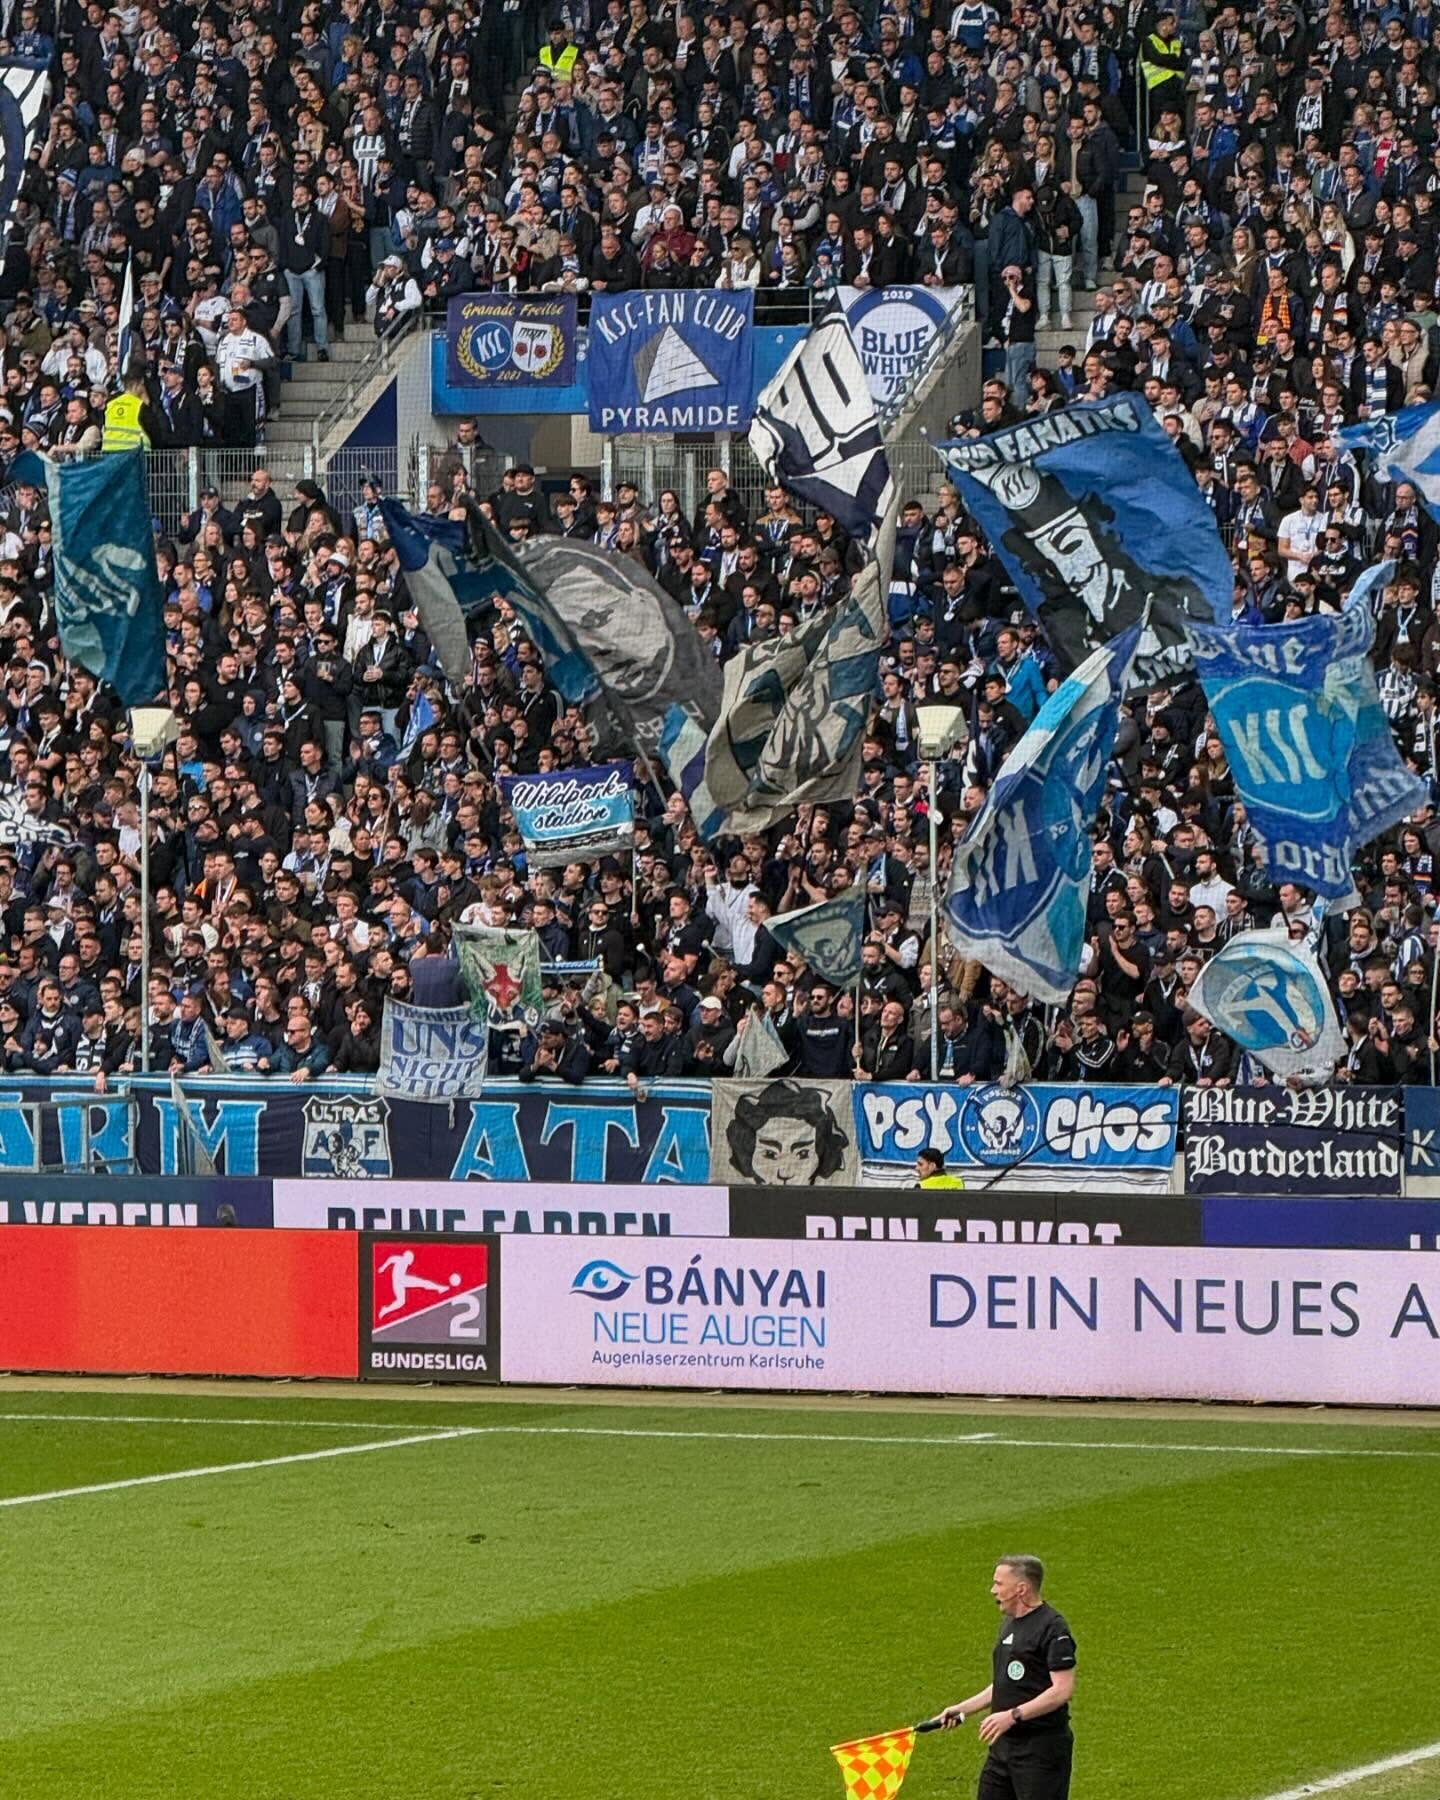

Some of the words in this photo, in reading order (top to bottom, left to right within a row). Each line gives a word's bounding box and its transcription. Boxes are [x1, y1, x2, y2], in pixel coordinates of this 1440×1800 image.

[596, 293, 686, 344] KSC-FAN
[694, 295, 746, 341] CLUB
[476, 328, 505, 362] KSC
[861, 325, 930, 357] BLUE
[602, 405, 740, 428] PYRAMIDE
[1228, 703, 1328, 785] KSC
[512, 771, 628, 811] Wildpark-
[532, 802, 610, 831] stadion
[391, 1018, 485, 1059] UNS
[311, 1104, 381, 1123] ULTRAS
[863, 1092, 958, 1151] PSY
[1045, 1095, 1171, 1160] CHOS
[1184, 1085, 1400, 1131] Blue-White
[450, 1101, 712, 1183] ATA
[1186, 1135, 1399, 1182] Borderland
[645, 1254, 826, 1308] BÁNYAI
[449, 1294, 481, 1338] 2
[930, 1273, 1098, 1331] DEIN
[1134, 1277, 1361, 1338] NEUES
[593, 1311, 689, 1345] NEUE
[699, 1314, 826, 1348] AUGEN
[370, 1351, 488, 1371] BUNDESLIGA
[591, 1350, 745, 1368] Augenlaserzentrum
[749, 1354, 825, 1370] Karlsruhe
